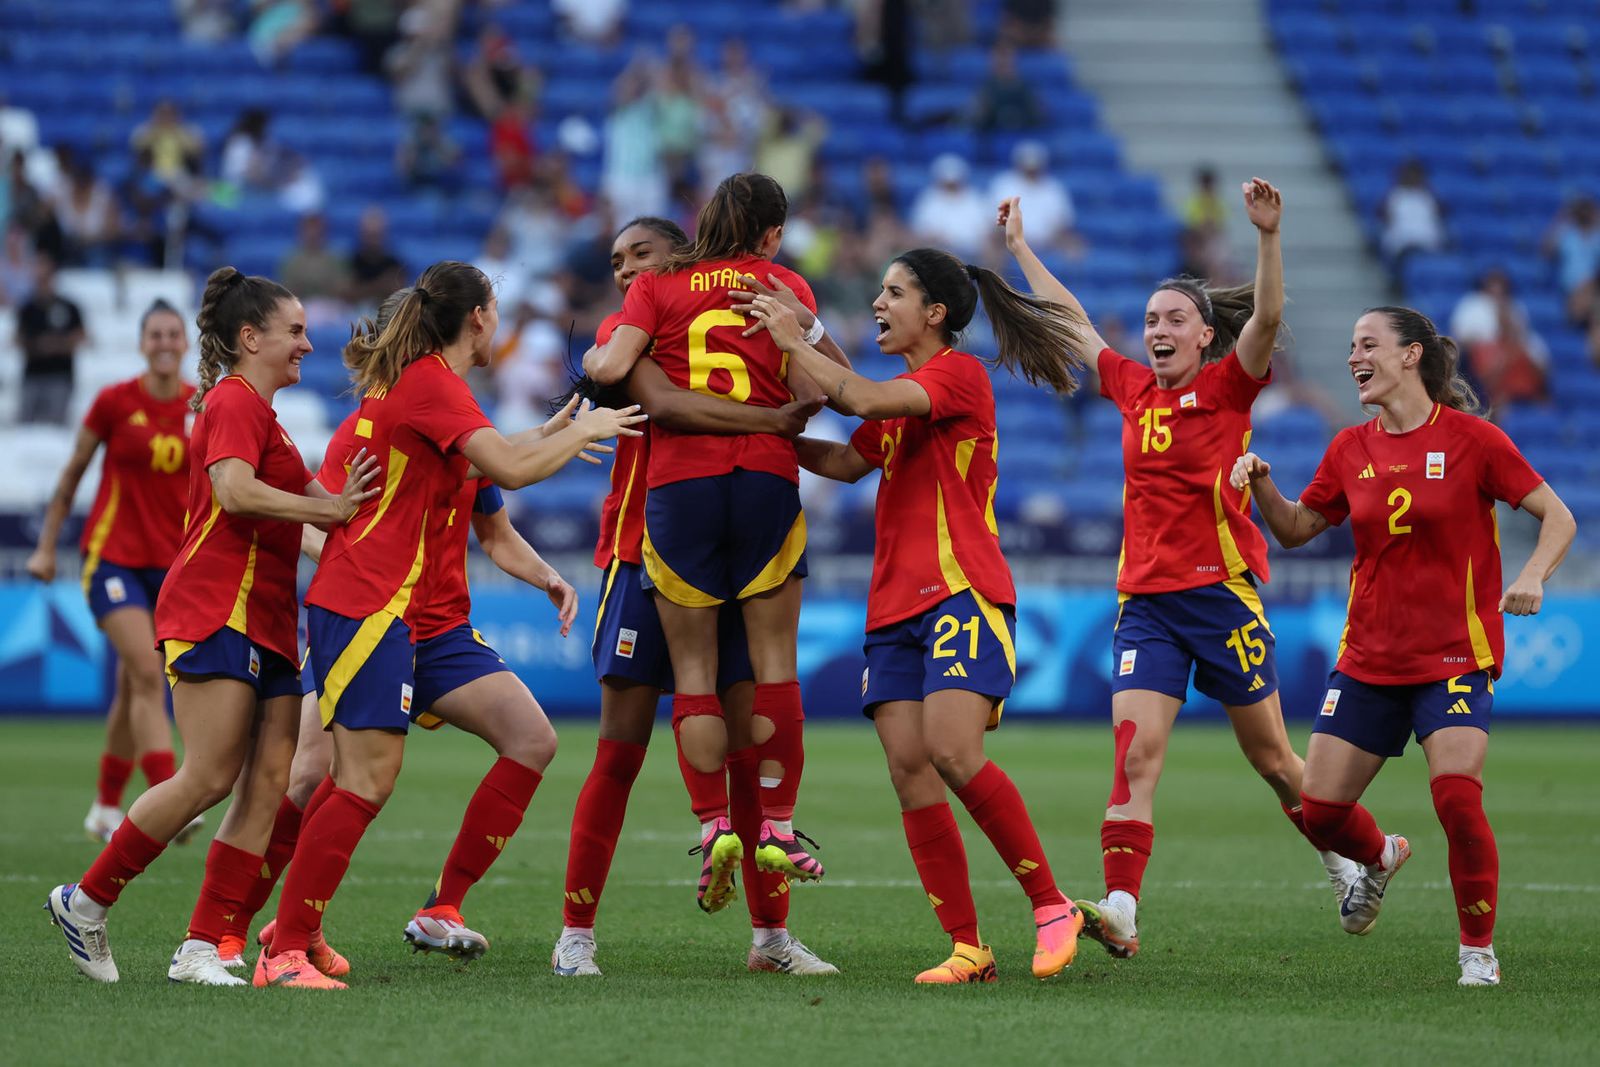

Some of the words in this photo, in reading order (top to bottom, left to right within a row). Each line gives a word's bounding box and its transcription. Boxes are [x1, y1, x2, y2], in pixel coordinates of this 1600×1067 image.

[688, 309, 751, 402] 6
[149, 432, 184, 474] 10
[1139, 408, 1172, 453] 15
[1387, 487, 1412, 535] 2
[933, 614, 980, 659] 21
[1226, 619, 1266, 673] 15
